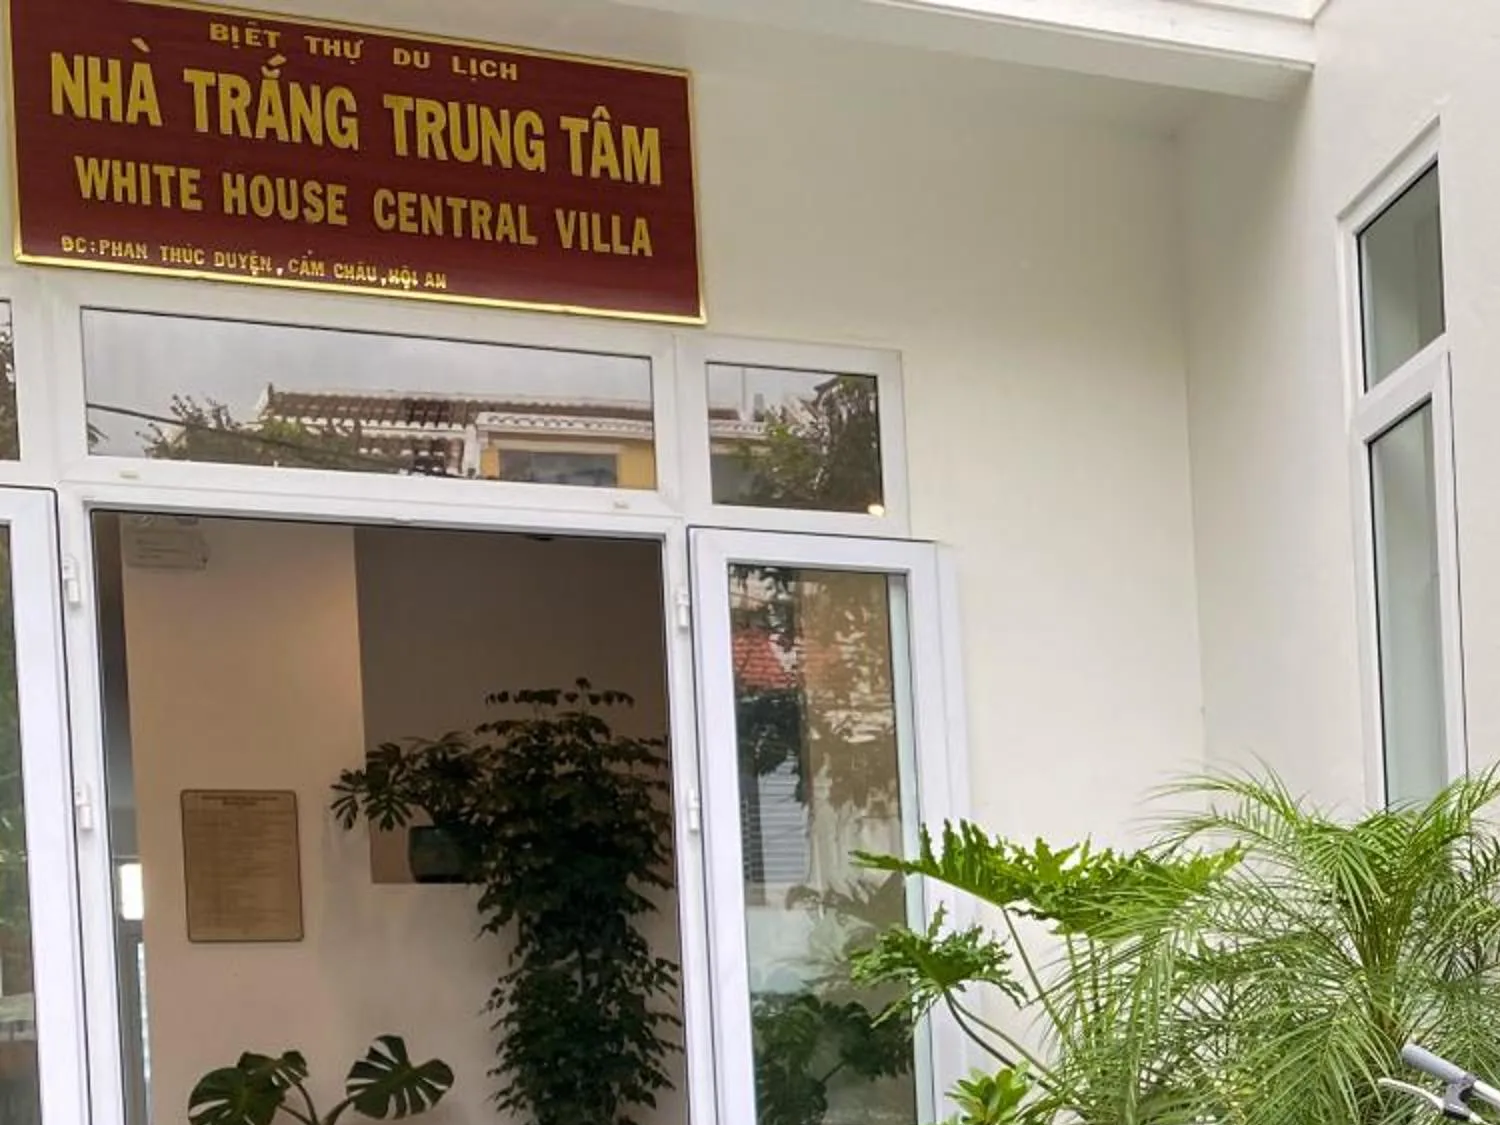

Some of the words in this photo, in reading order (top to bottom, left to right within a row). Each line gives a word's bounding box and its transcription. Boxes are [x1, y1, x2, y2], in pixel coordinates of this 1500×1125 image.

[393, 47, 431, 69] DU
[452, 55, 518, 81] LỊCH
[51, 37, 163, 127] NHÀ
[183, 54, 359, 151] TRẮNG
[384, 93, 546, 173] TRUNG
[560, 105, 662, 186] TÂM
[74, 155, 203, 211] WHITE
[222, 172, 348, 226] HOUSE
[373, 188, 538, 246] CENTRAL
[555, 207, 653, 257] VILLA
[424, 272, 447, 289] AN
